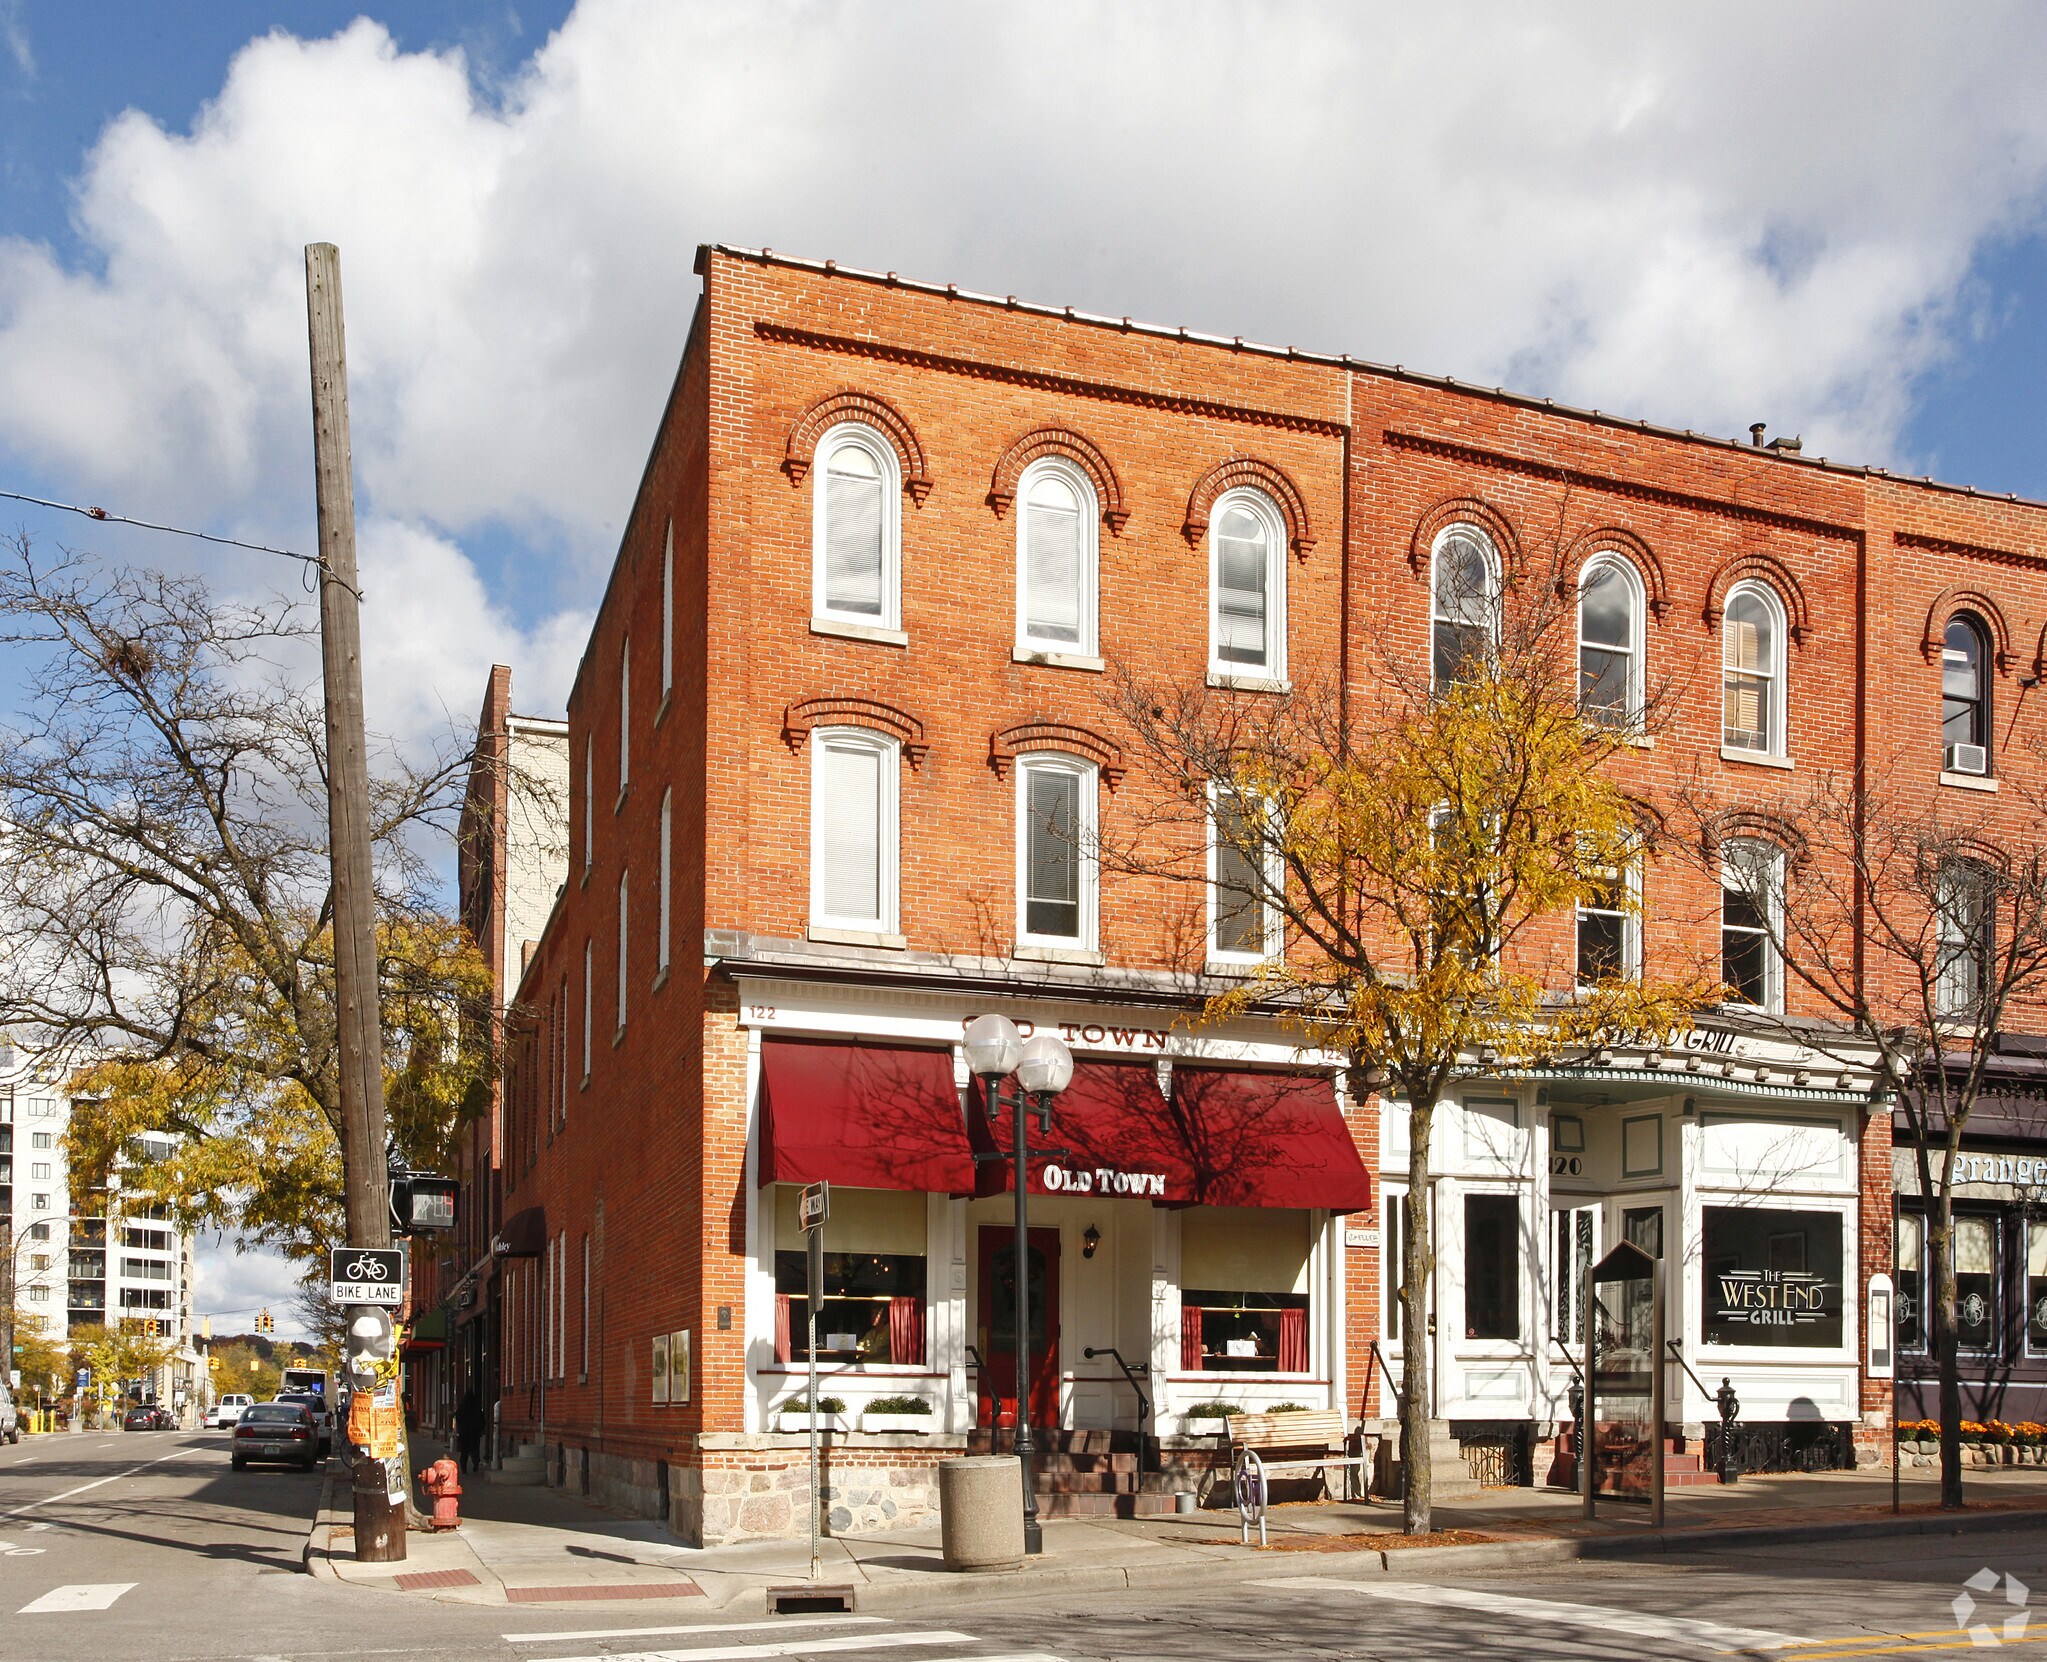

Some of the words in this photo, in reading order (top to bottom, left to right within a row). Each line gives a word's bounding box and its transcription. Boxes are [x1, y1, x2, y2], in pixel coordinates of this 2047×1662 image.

[750, 1004, 776, 1020] 122
[1058, 1022, 1170, 1049] TOWN
[1685, 1029, 1737, 1054] GRILL
[1549, 1156, 1582, 1176] 120
[1763, 1269, 1781, 1283] THE
[336, 1285, 362, 1298] BIKE
[368, 1286, 397, 1300] LANE
[1721, 1281, 1779, 1308] WEST
[1783, 1283, 1824, 1310] END
[1749, 1309, 1795, 1326] GRILL
